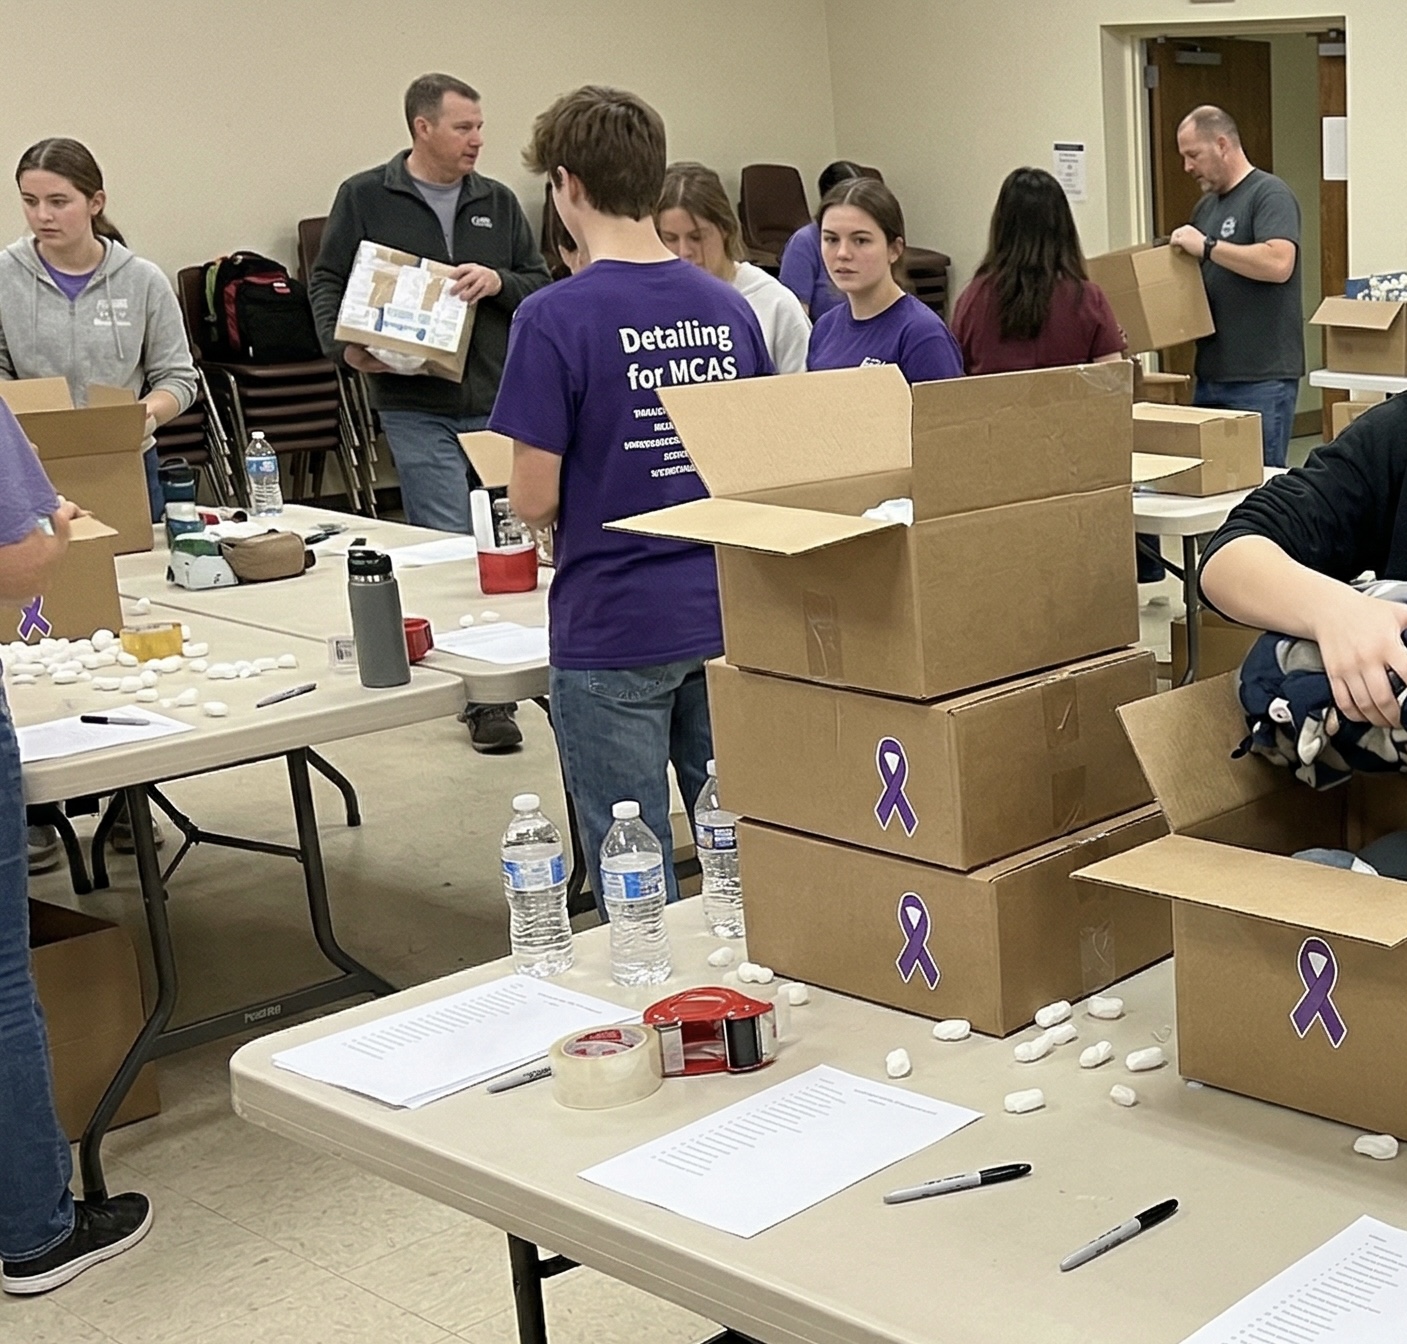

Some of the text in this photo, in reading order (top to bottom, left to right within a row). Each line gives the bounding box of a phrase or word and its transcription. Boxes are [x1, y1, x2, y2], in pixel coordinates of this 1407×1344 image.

[619, 320, 733, 353] Detailing
[627, 356, 737, 390] for MCAS
